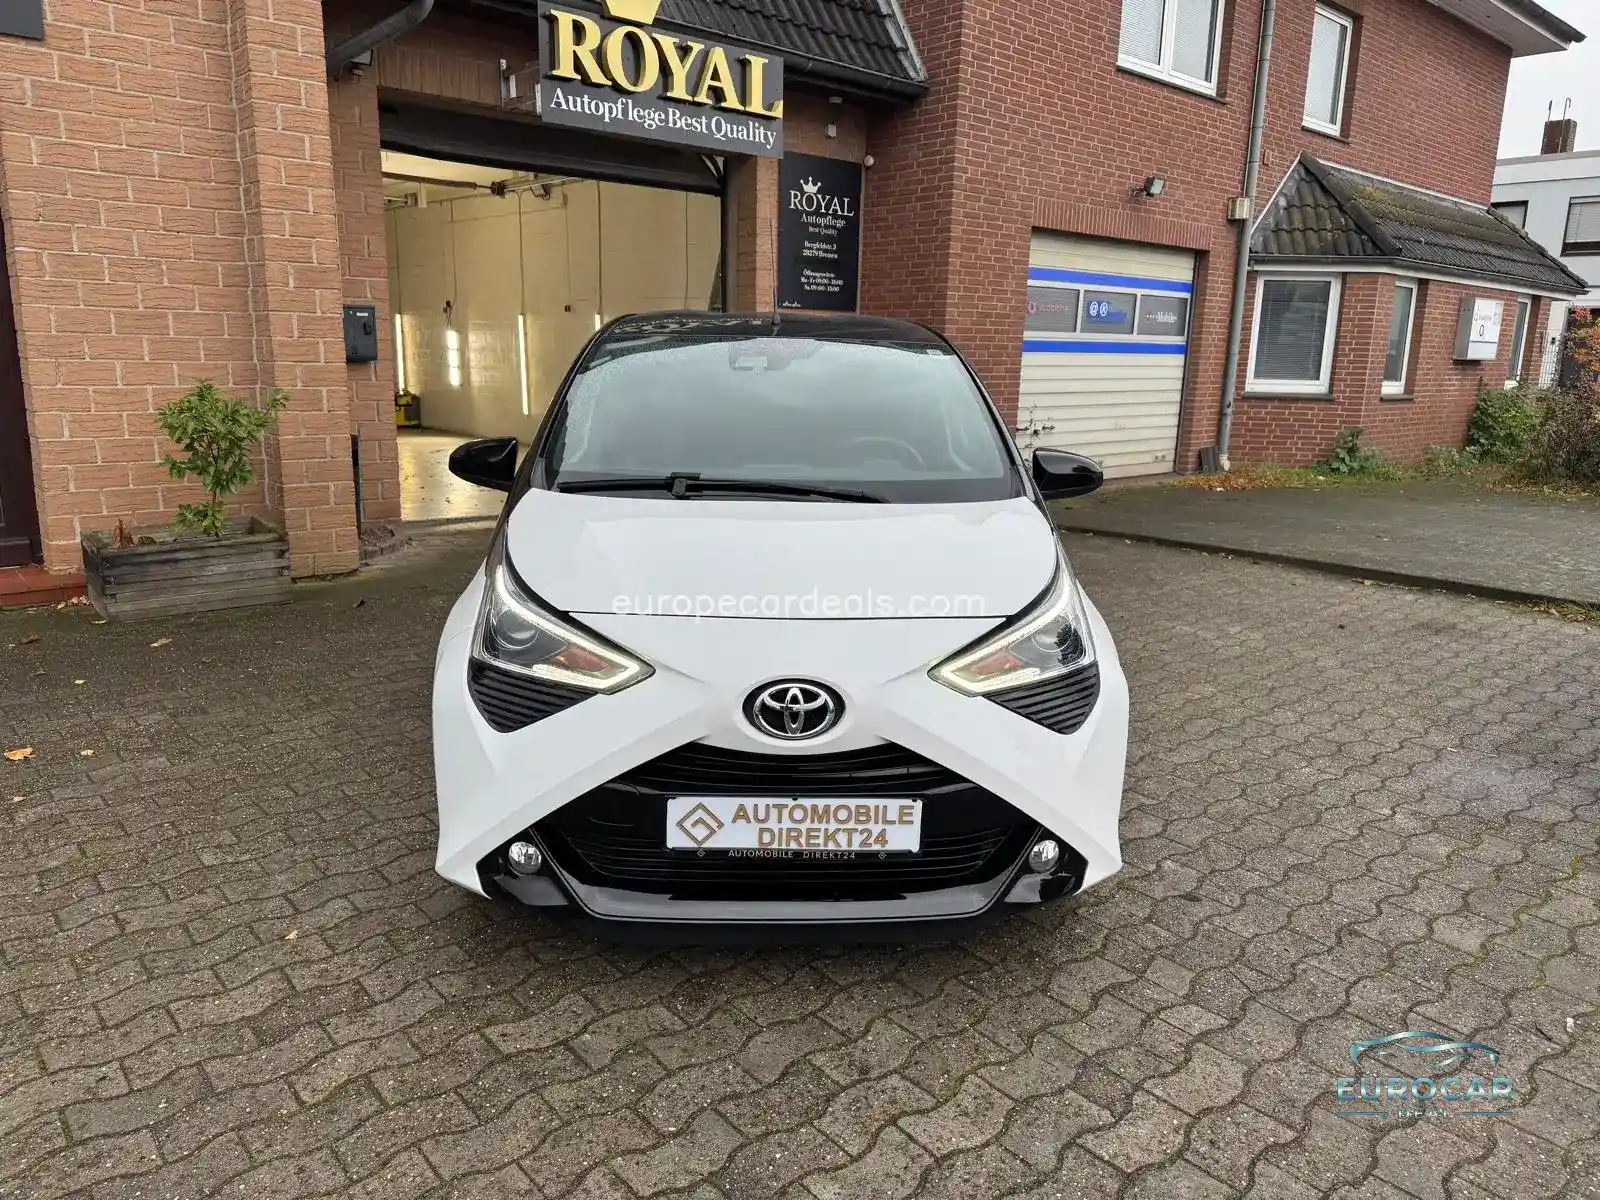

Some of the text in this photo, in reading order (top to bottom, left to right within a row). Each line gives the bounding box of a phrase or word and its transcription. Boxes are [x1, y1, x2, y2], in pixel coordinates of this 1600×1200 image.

[548, 9, 783, 119] ROYAL
[550, 87, 777, 149] Autopflege Best Quality
[789, 191, 855, 216] ROYAL
[801, 213, 846, 228] Autopflege
[820, 228, 838, 236] Quality
[731, 803, 915, 826] AUTOMOBILE
[757, 827, 889, 850] DIREKT24
[728, 850, 856, 860] AUTOMOBILE DIREKT24
